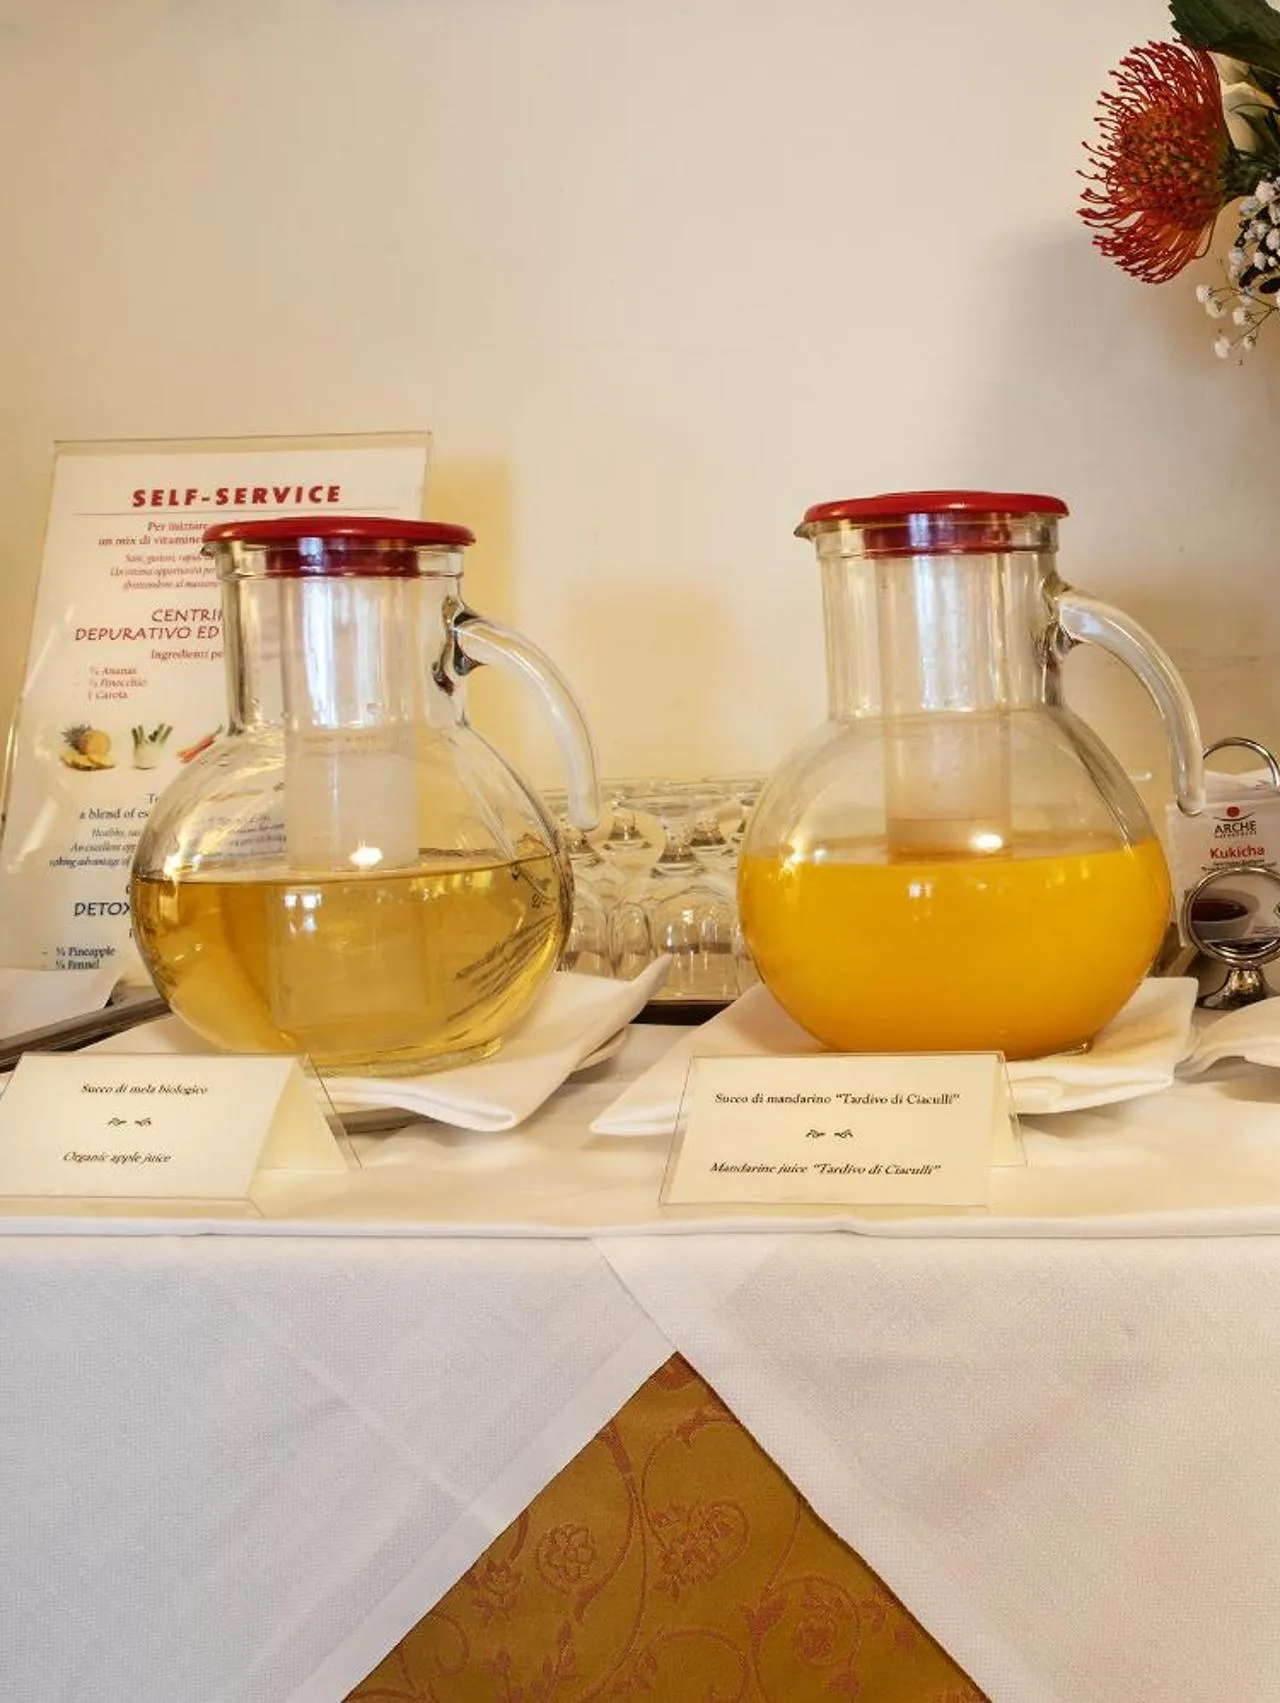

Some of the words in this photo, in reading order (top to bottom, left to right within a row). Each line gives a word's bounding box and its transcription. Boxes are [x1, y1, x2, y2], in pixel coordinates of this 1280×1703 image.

[132, 485, 342, 508] SELF-SERVICE
[75, 625, 191, 641] DEPURATIVO
[196, 625, 220, 640] ED
[210, 650, 223, 662] pe
[88, 807, 121, 820] blend
[124, 807, 136, 819] of
[1214, 820, 1257, 834] ARCHE
[1210, 845, 1266, 860] Kukicha
[74, 901, 131, 918] DETOX
[68, 945, 117, 959] Pineapple
[80, 1082, 113, 1095] Succo
[115, 1083, 128, 1094] di
[158, 1083, 209, 1097] biologico
[715, 1092, 749, 1105] Succo
[751, 1092, 764, 1105] di
[767, 1092, 832, 1105] mandarino
[890, 1093, 903, 1105] di
[62, 1151, 108, 1164] Organic
[110, 1152, 143, 1165] apple
[143, 1152, 172, 1164] juice
[710, 1161, 776, 1174] Mandarine
[777, 1162, 808, 1176] juice
[868, 1163, 883, 1175] di
